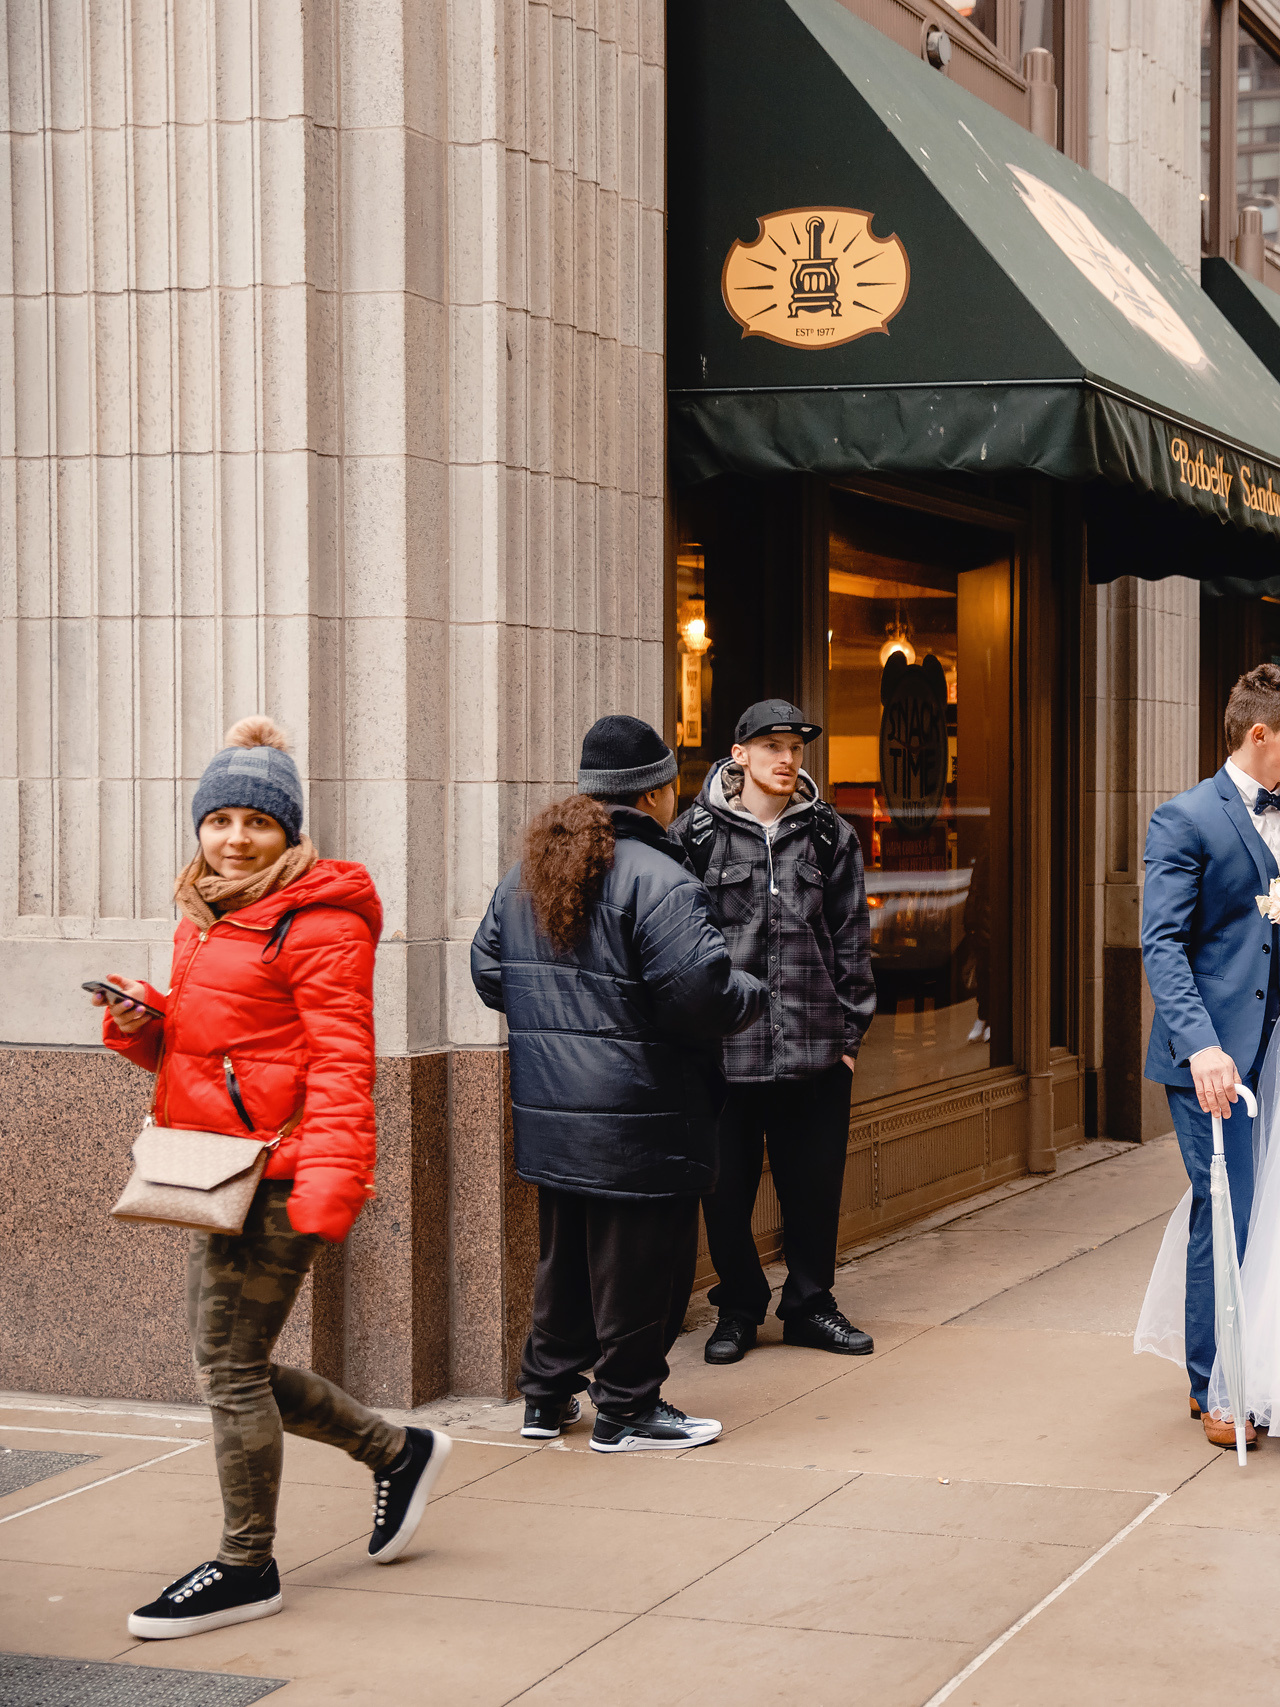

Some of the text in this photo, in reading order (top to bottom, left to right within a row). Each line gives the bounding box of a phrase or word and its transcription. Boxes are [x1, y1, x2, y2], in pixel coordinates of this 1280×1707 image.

[816, 327, 836, 337] 1977
[1171, 438, 1233, 508] Potbelly
[889, 748, 937, 799] TIME
